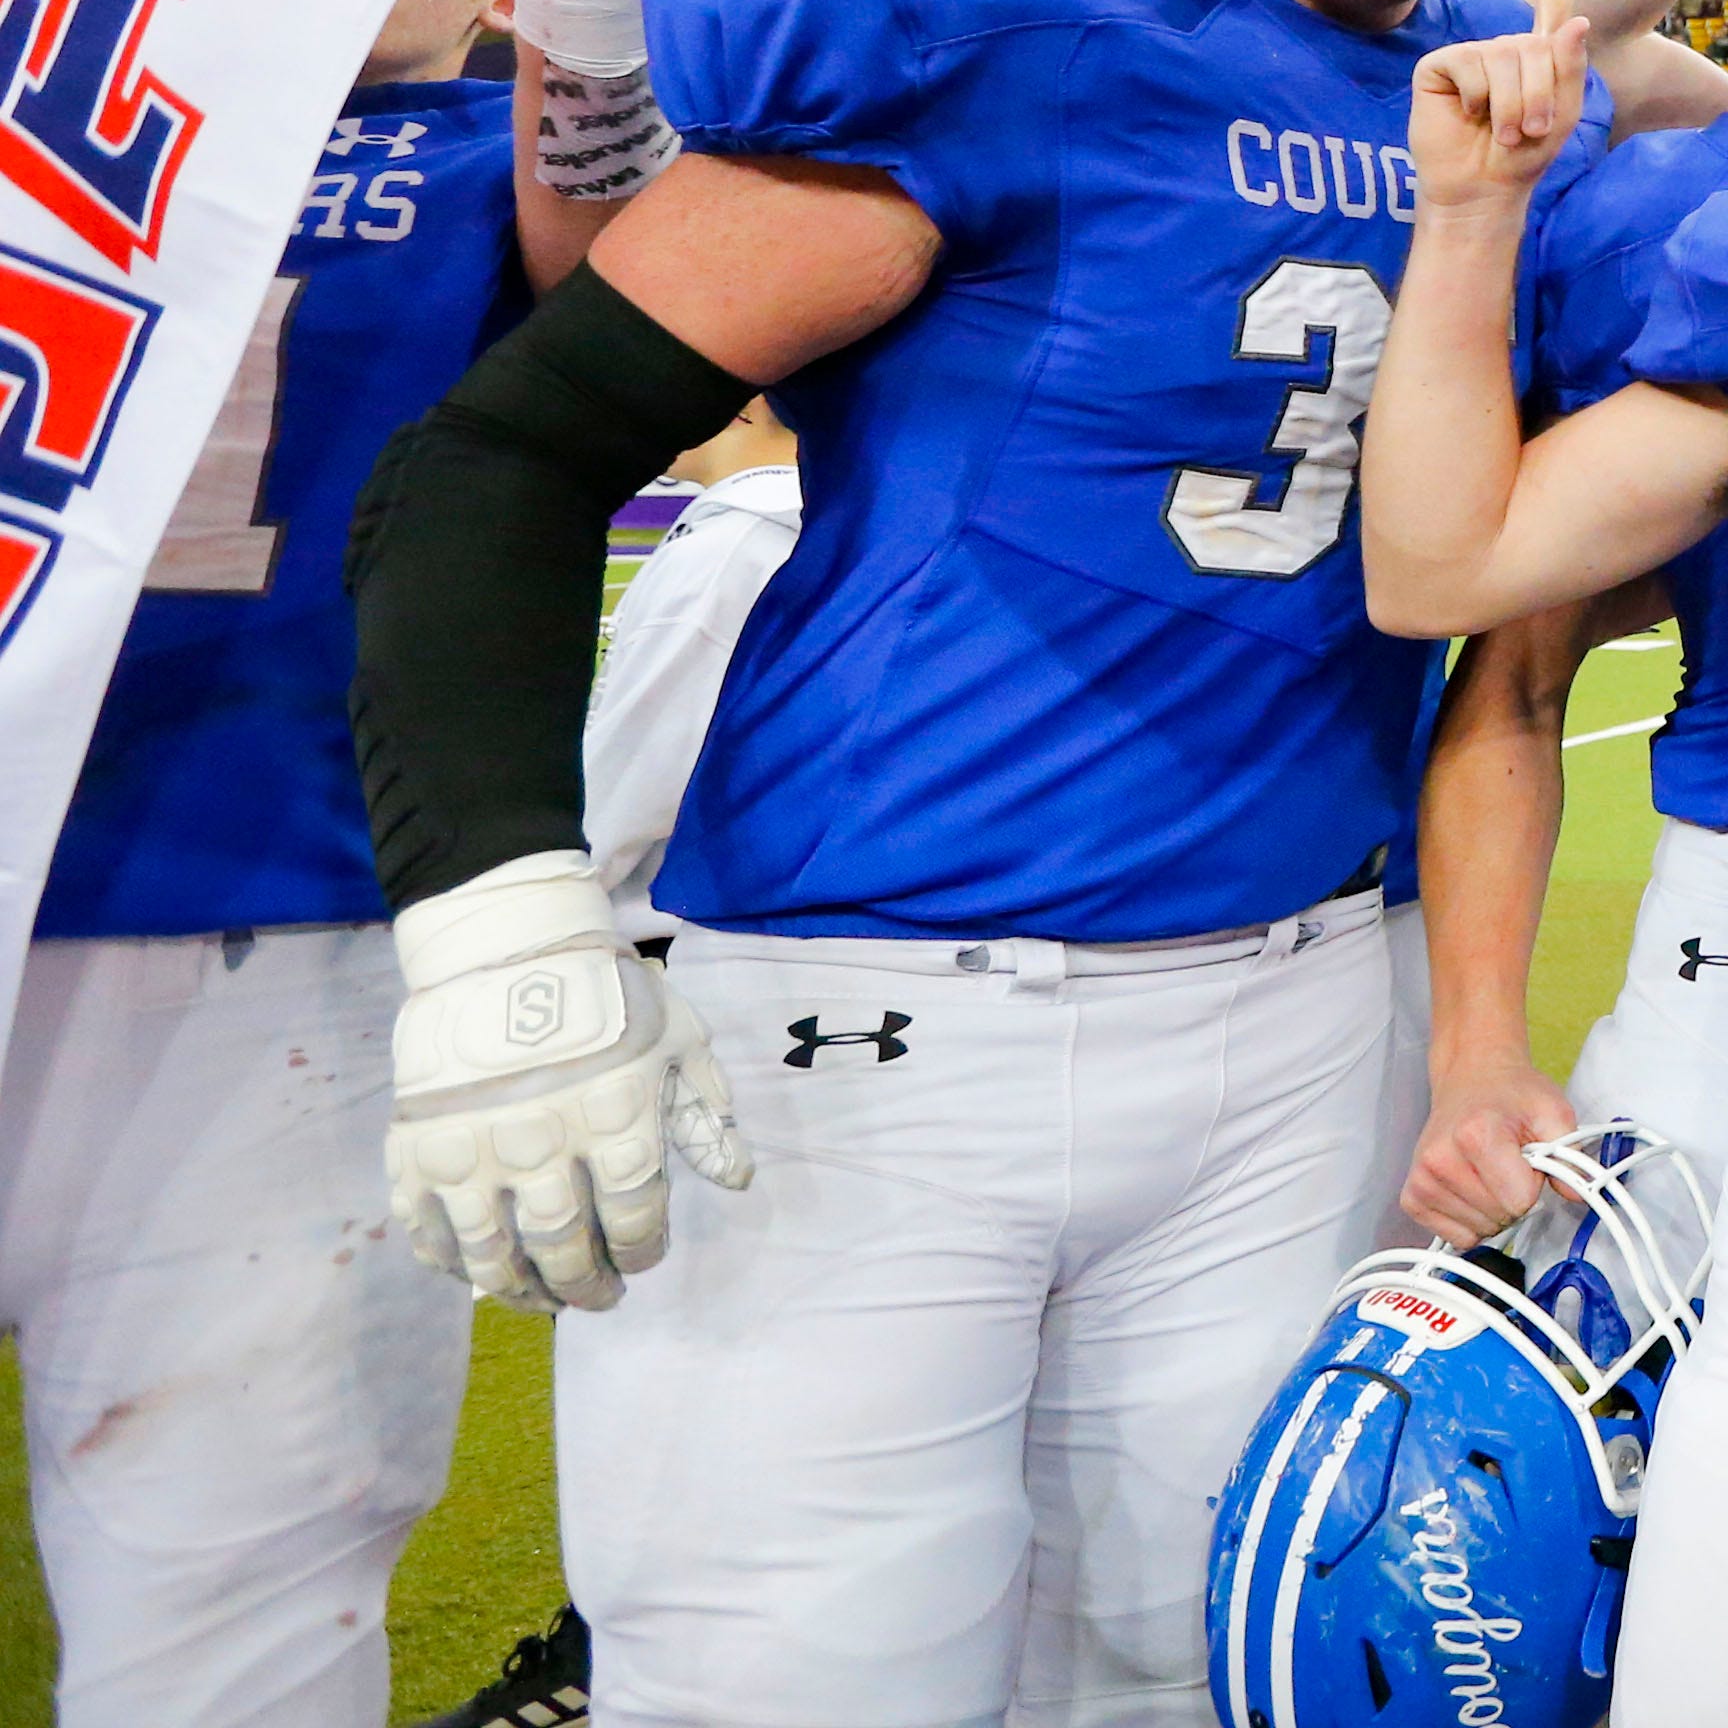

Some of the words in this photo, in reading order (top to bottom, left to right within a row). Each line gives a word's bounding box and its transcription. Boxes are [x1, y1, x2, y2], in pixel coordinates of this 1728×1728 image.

[1226, 118, 1417, 224] COUG
[1159, 255, 1396, 581] 3
[1366, 1289, 1458, 1334] Riddell
[1400, 1486, 1524, 1728] ougars
